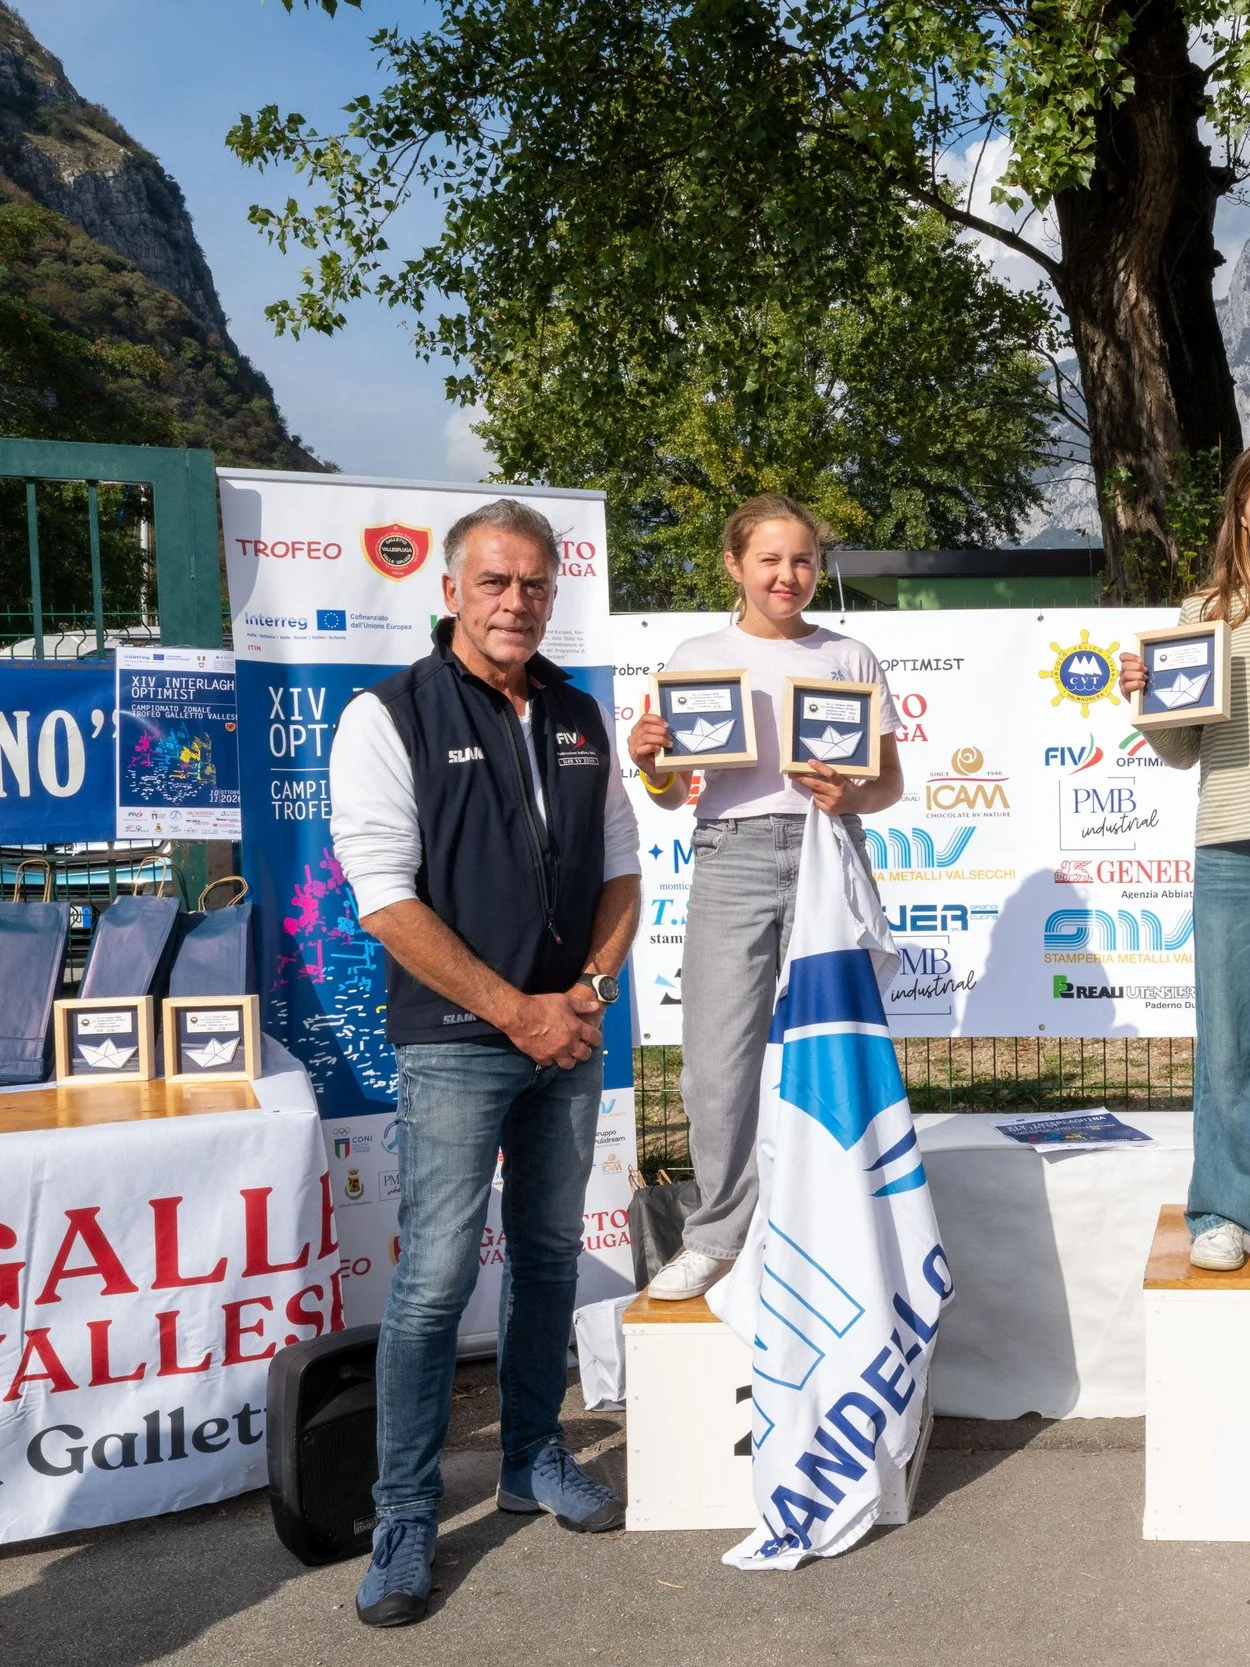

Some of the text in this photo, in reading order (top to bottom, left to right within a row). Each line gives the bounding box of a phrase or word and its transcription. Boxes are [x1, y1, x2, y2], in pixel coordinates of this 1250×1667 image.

[235, 538, 342, 560] TROFEO
[245, 611, 308, 631] Interreg
[350, 613, 389, 622] Cofinanziato
[386, 624, 412, 632] Europea
[878, 658, 965, 671] OPTIMIST
[131, 676, 156, 688] XIV
[1070, 676, 1100, 685] CVT
[131, 687, 196, 700] OPTIMIST
[131, 704, 211, 714] CAMPIONATO ZONALE
[268, 686, 326, 721] XIV
[269, 723, 336, 757] OPT
[556, 732, 577, 745] FIV
[1044, 746, 1087, 766] FIV
[926, 783, 1010, 811] ICAM
[1072, 788, 1137, 814] PMB
[1081, 809, 1160, 839] industrial
[889, 870, 942, 881] METALLI
[945, 869, 1016, 881] VALSECCHI
[1121, 890, 1159, 899] Agenzia
[897, 948, 952, 976] MB
[1044, 953, 1113, 964] STAMPERIA
[1117, 953, 1170, 963] METALLI
[891, 969, 977, 1002] industrial
[1076, 986, 1124, 999] REALI
[1145, 1001, 1182, 1009] Paderno
[352, 1135, 373, 1144] CONI
[26, 1402, 268, 1477] Gallet
